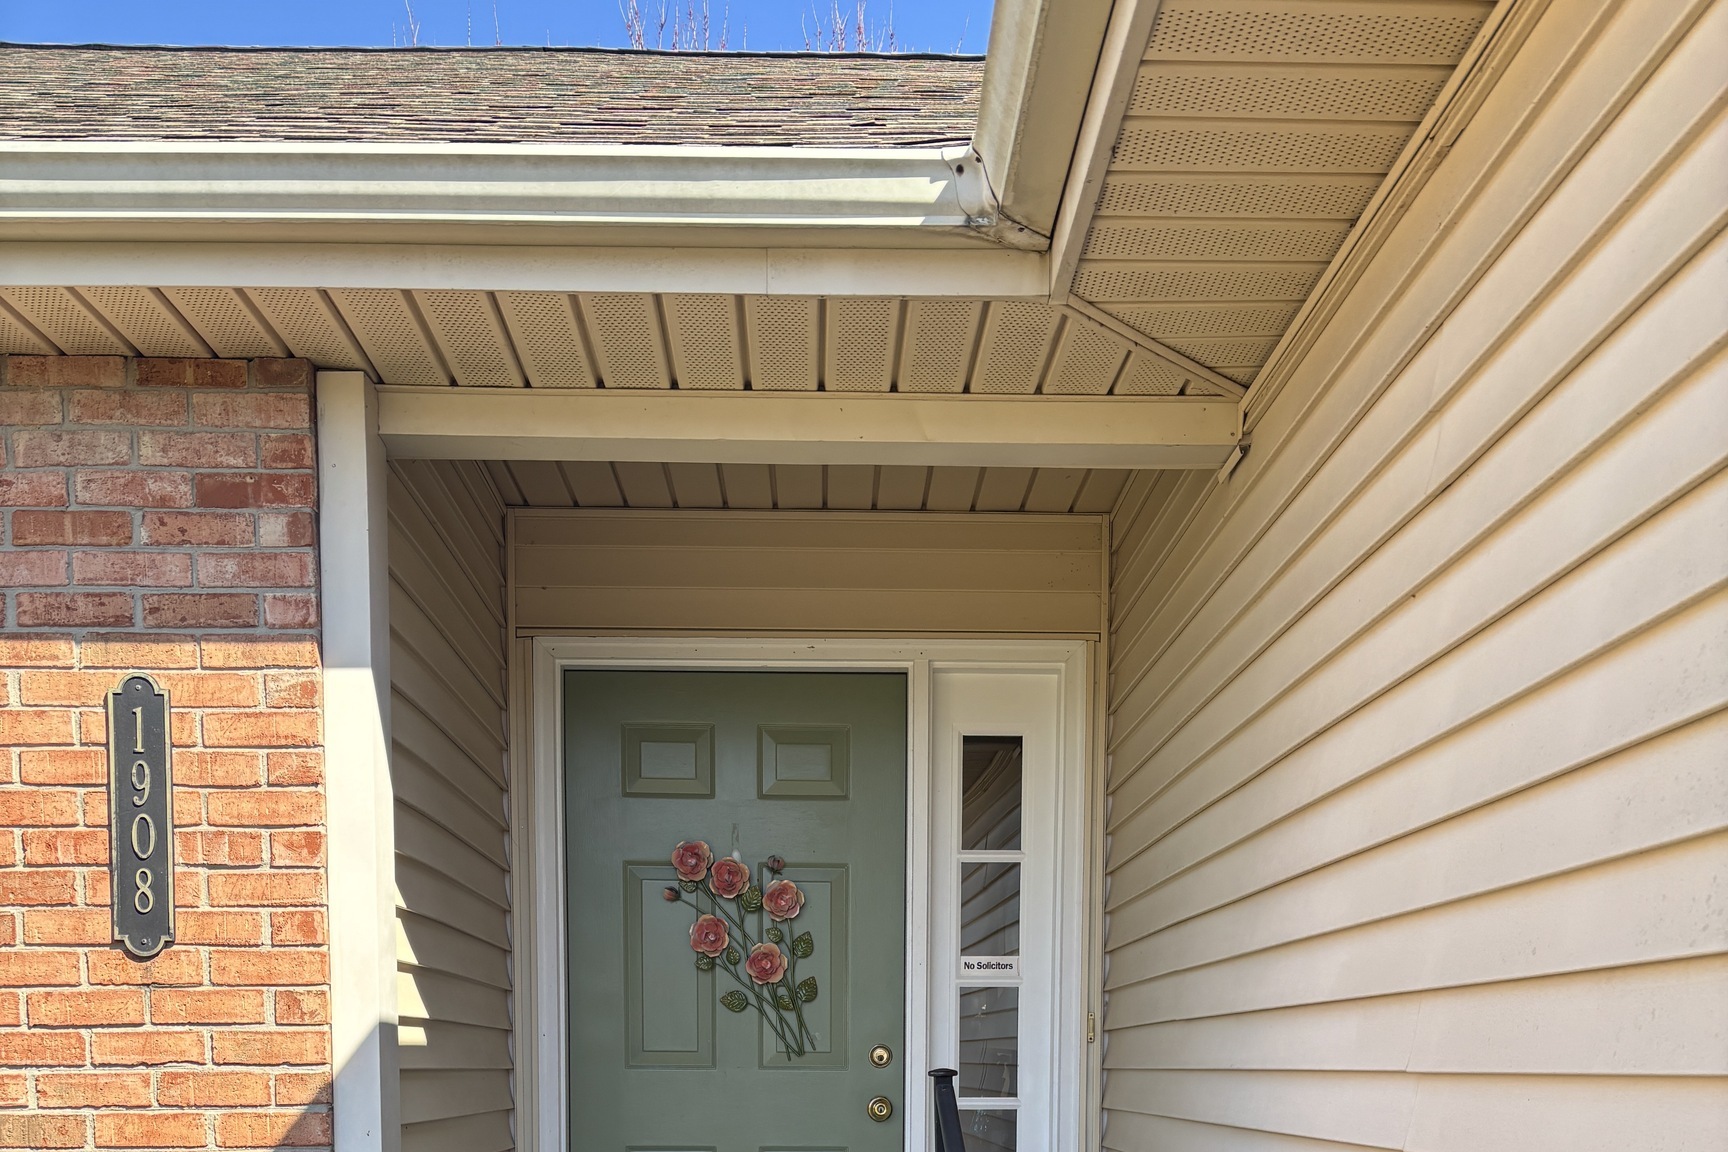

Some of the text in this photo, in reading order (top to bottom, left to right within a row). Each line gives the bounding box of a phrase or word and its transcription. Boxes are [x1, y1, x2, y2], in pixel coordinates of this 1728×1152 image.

[131, 706, 156, 914] 1908
[963, 961, 1014, 970] No Solicitors
